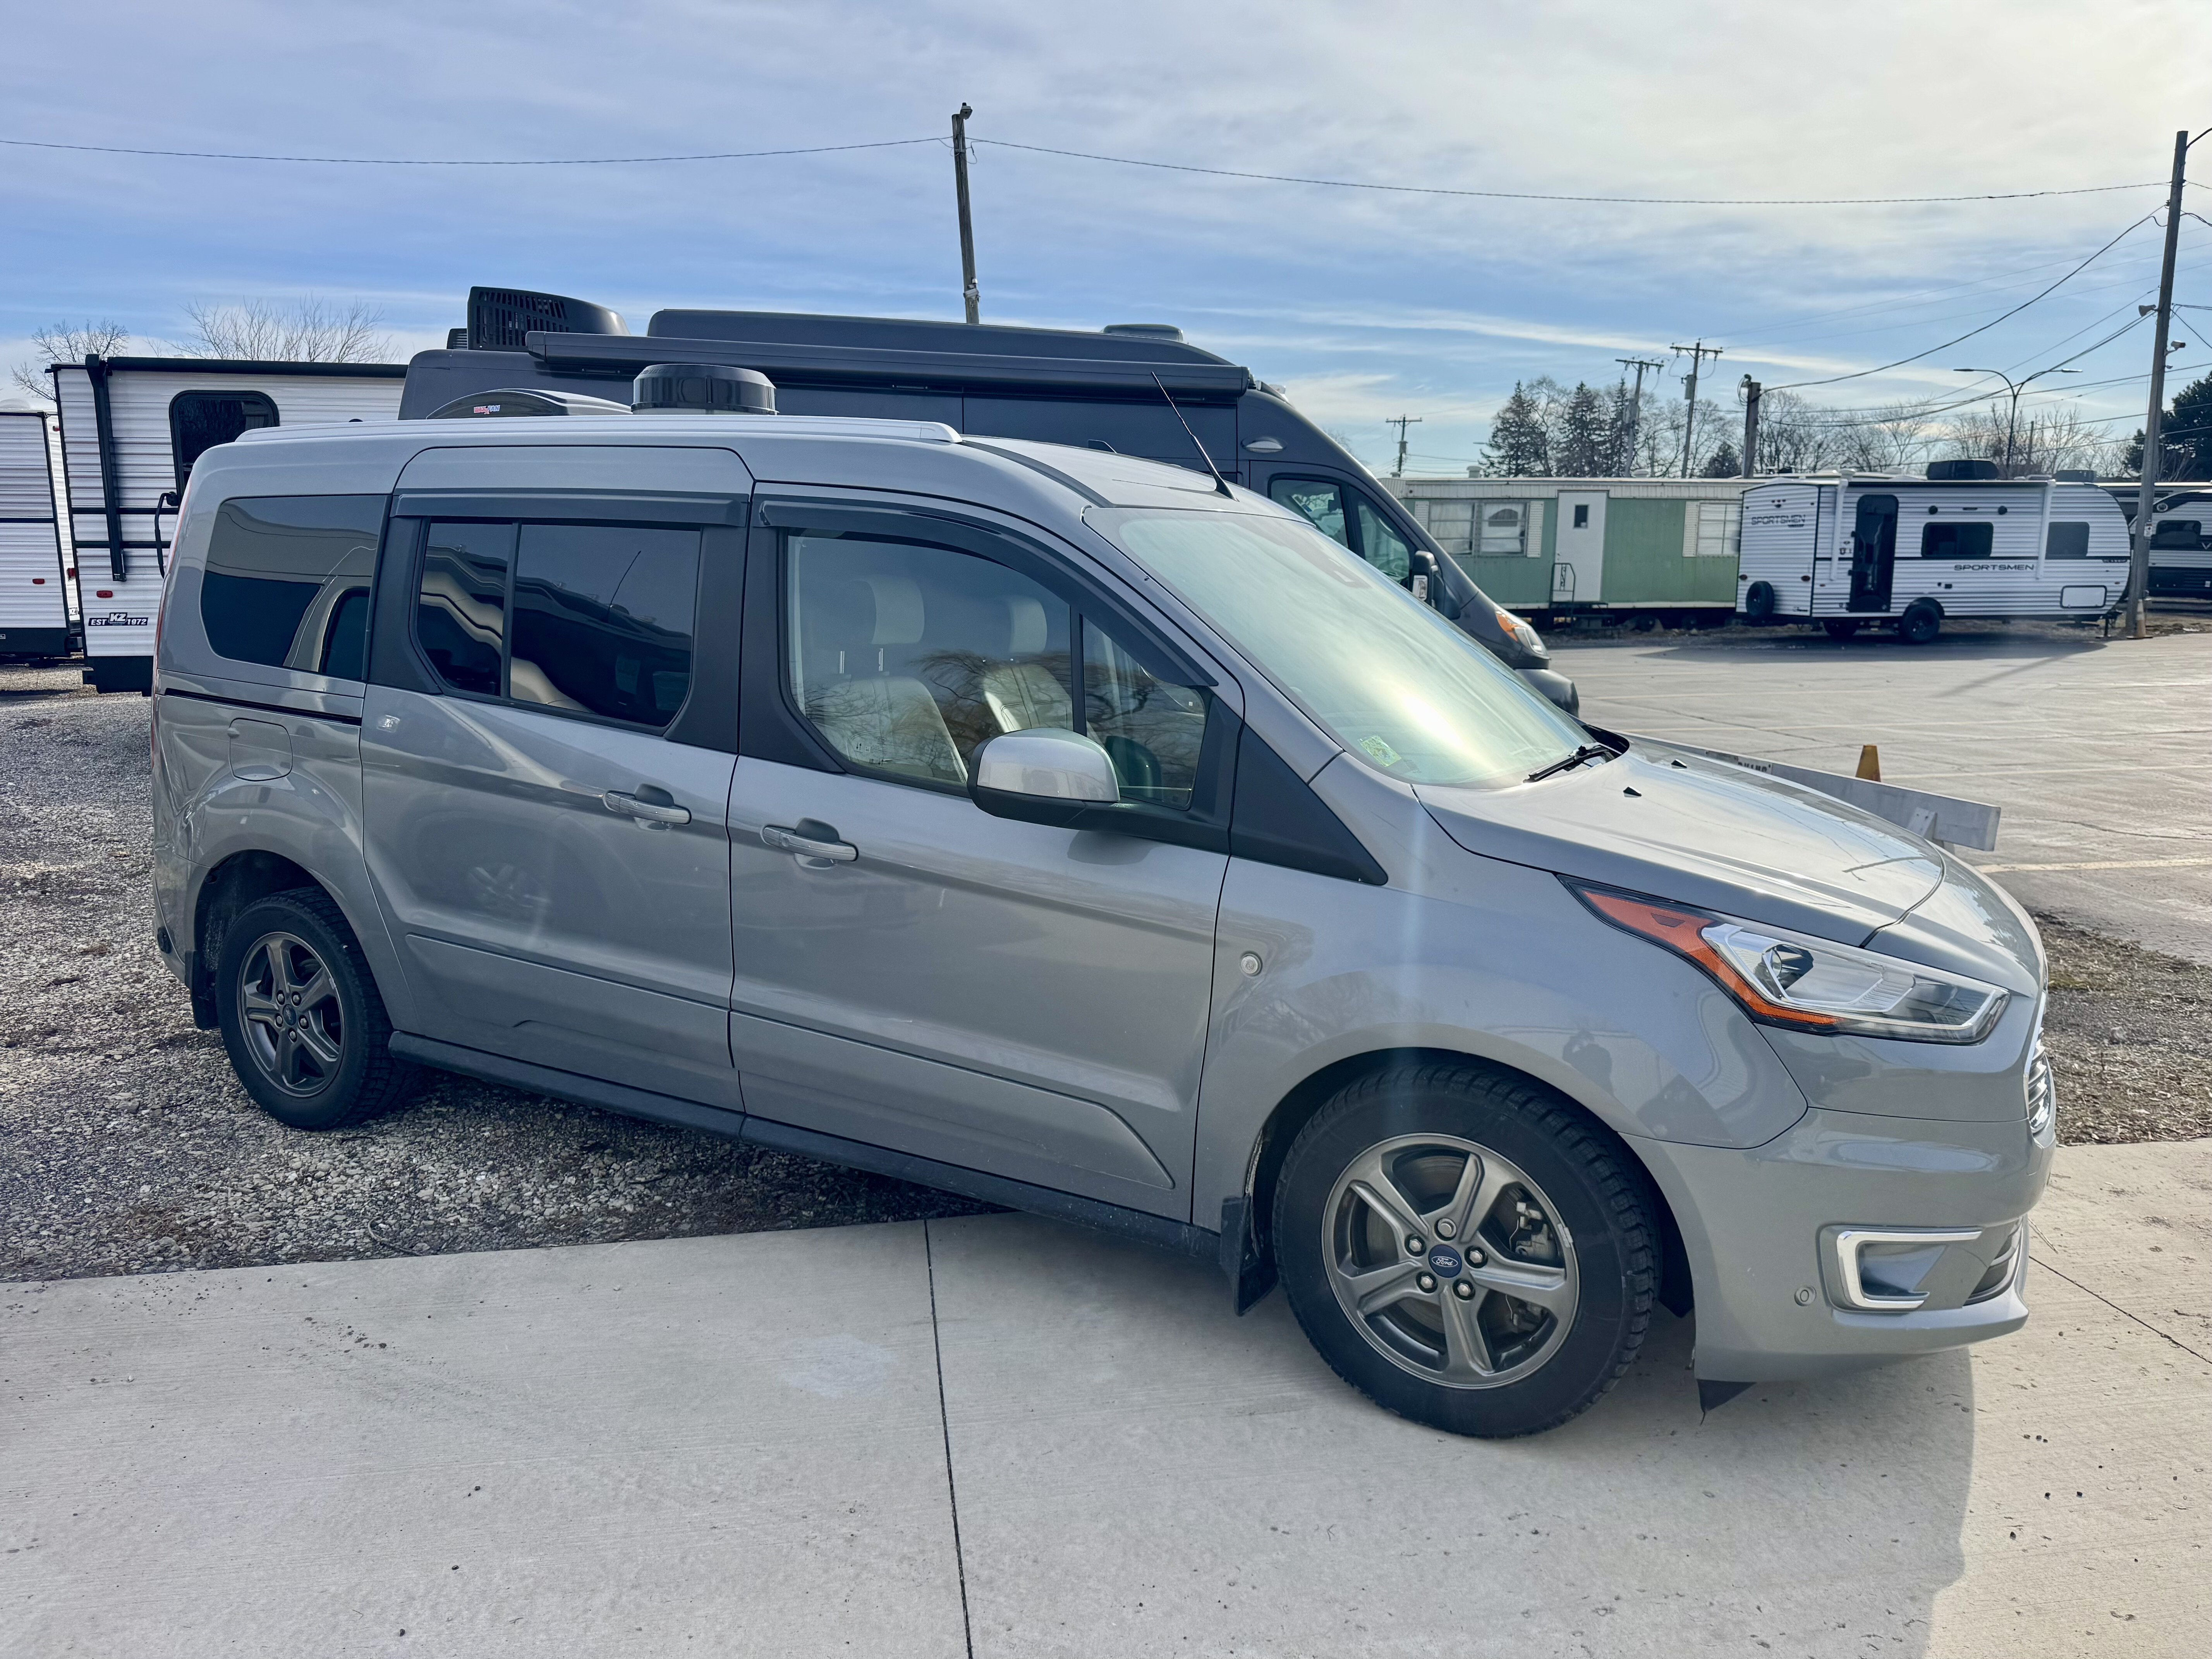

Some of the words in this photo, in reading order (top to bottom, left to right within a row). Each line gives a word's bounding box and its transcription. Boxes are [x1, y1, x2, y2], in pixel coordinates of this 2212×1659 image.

[1751, 514, 1806, 525] SPORTSMEN
[110, 613, 126, 622] KZ
[1436, 1257, 1453, 1266] Ford
